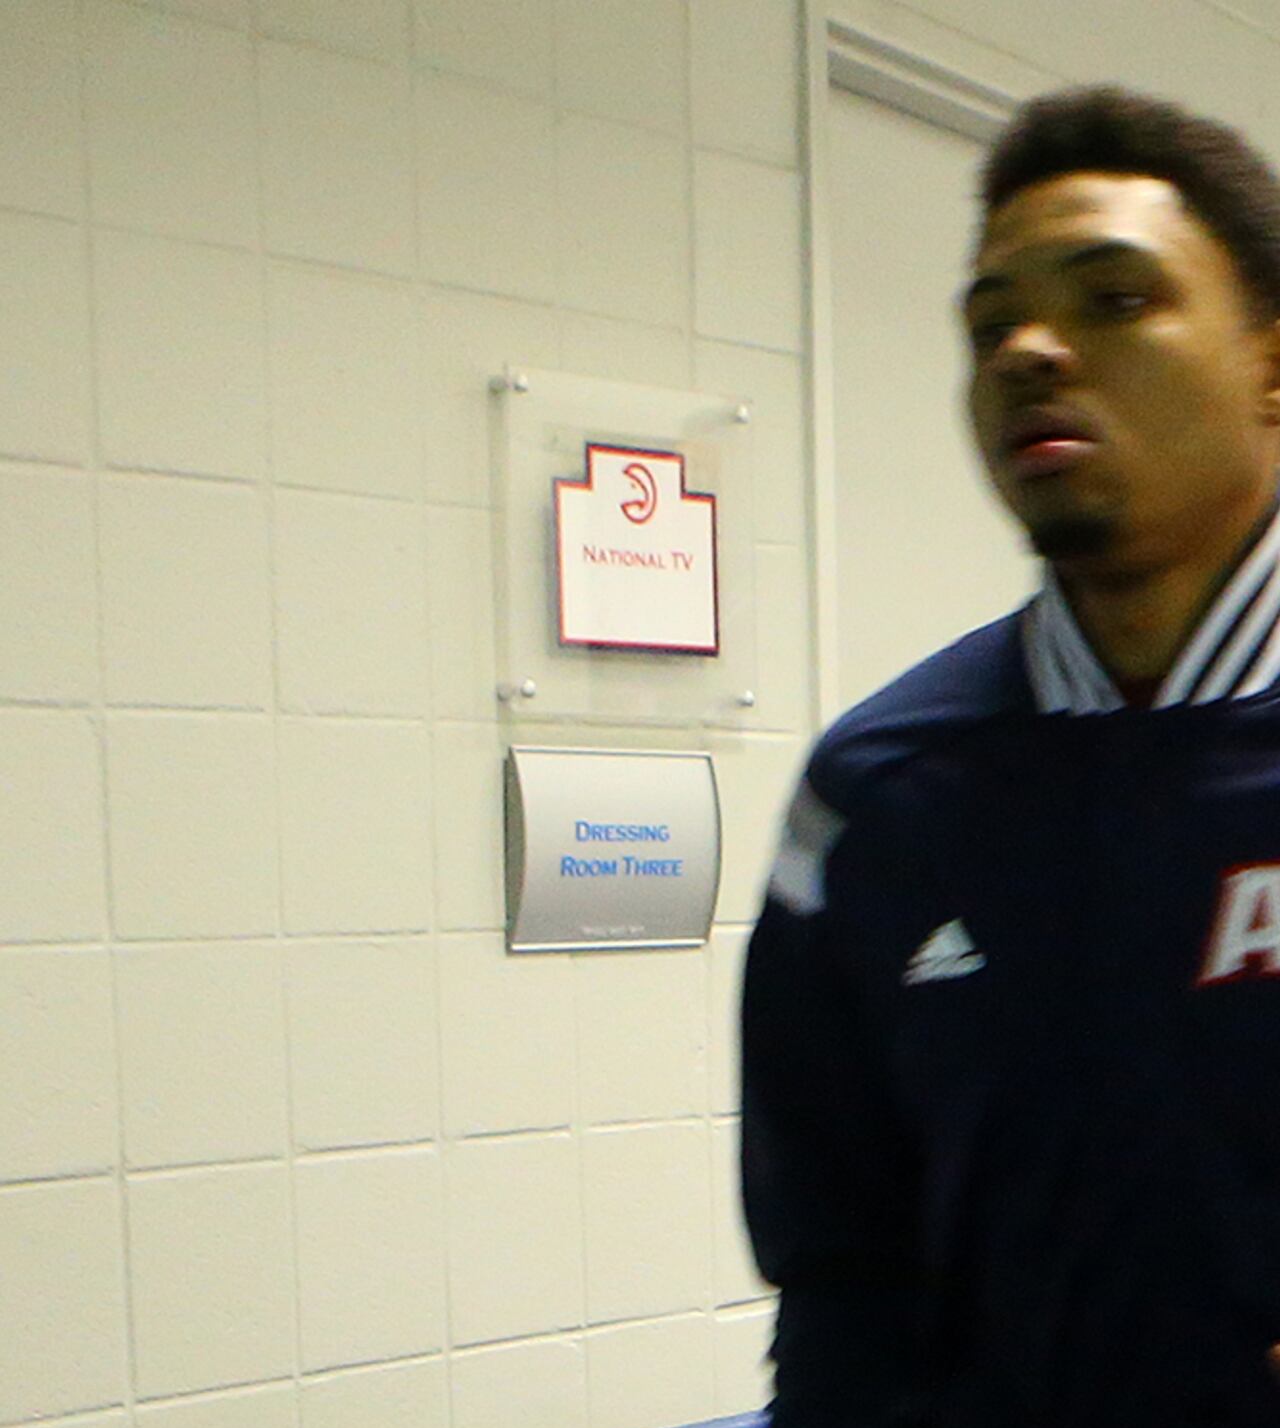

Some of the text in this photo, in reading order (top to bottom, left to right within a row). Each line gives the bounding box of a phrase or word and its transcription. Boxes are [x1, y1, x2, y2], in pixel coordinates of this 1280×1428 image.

[582, 544, 694, 571] NATIONAL TV
[575, 820, 670, 842] DRESSING
[560, 855, 684, 877] ROOM THREE
